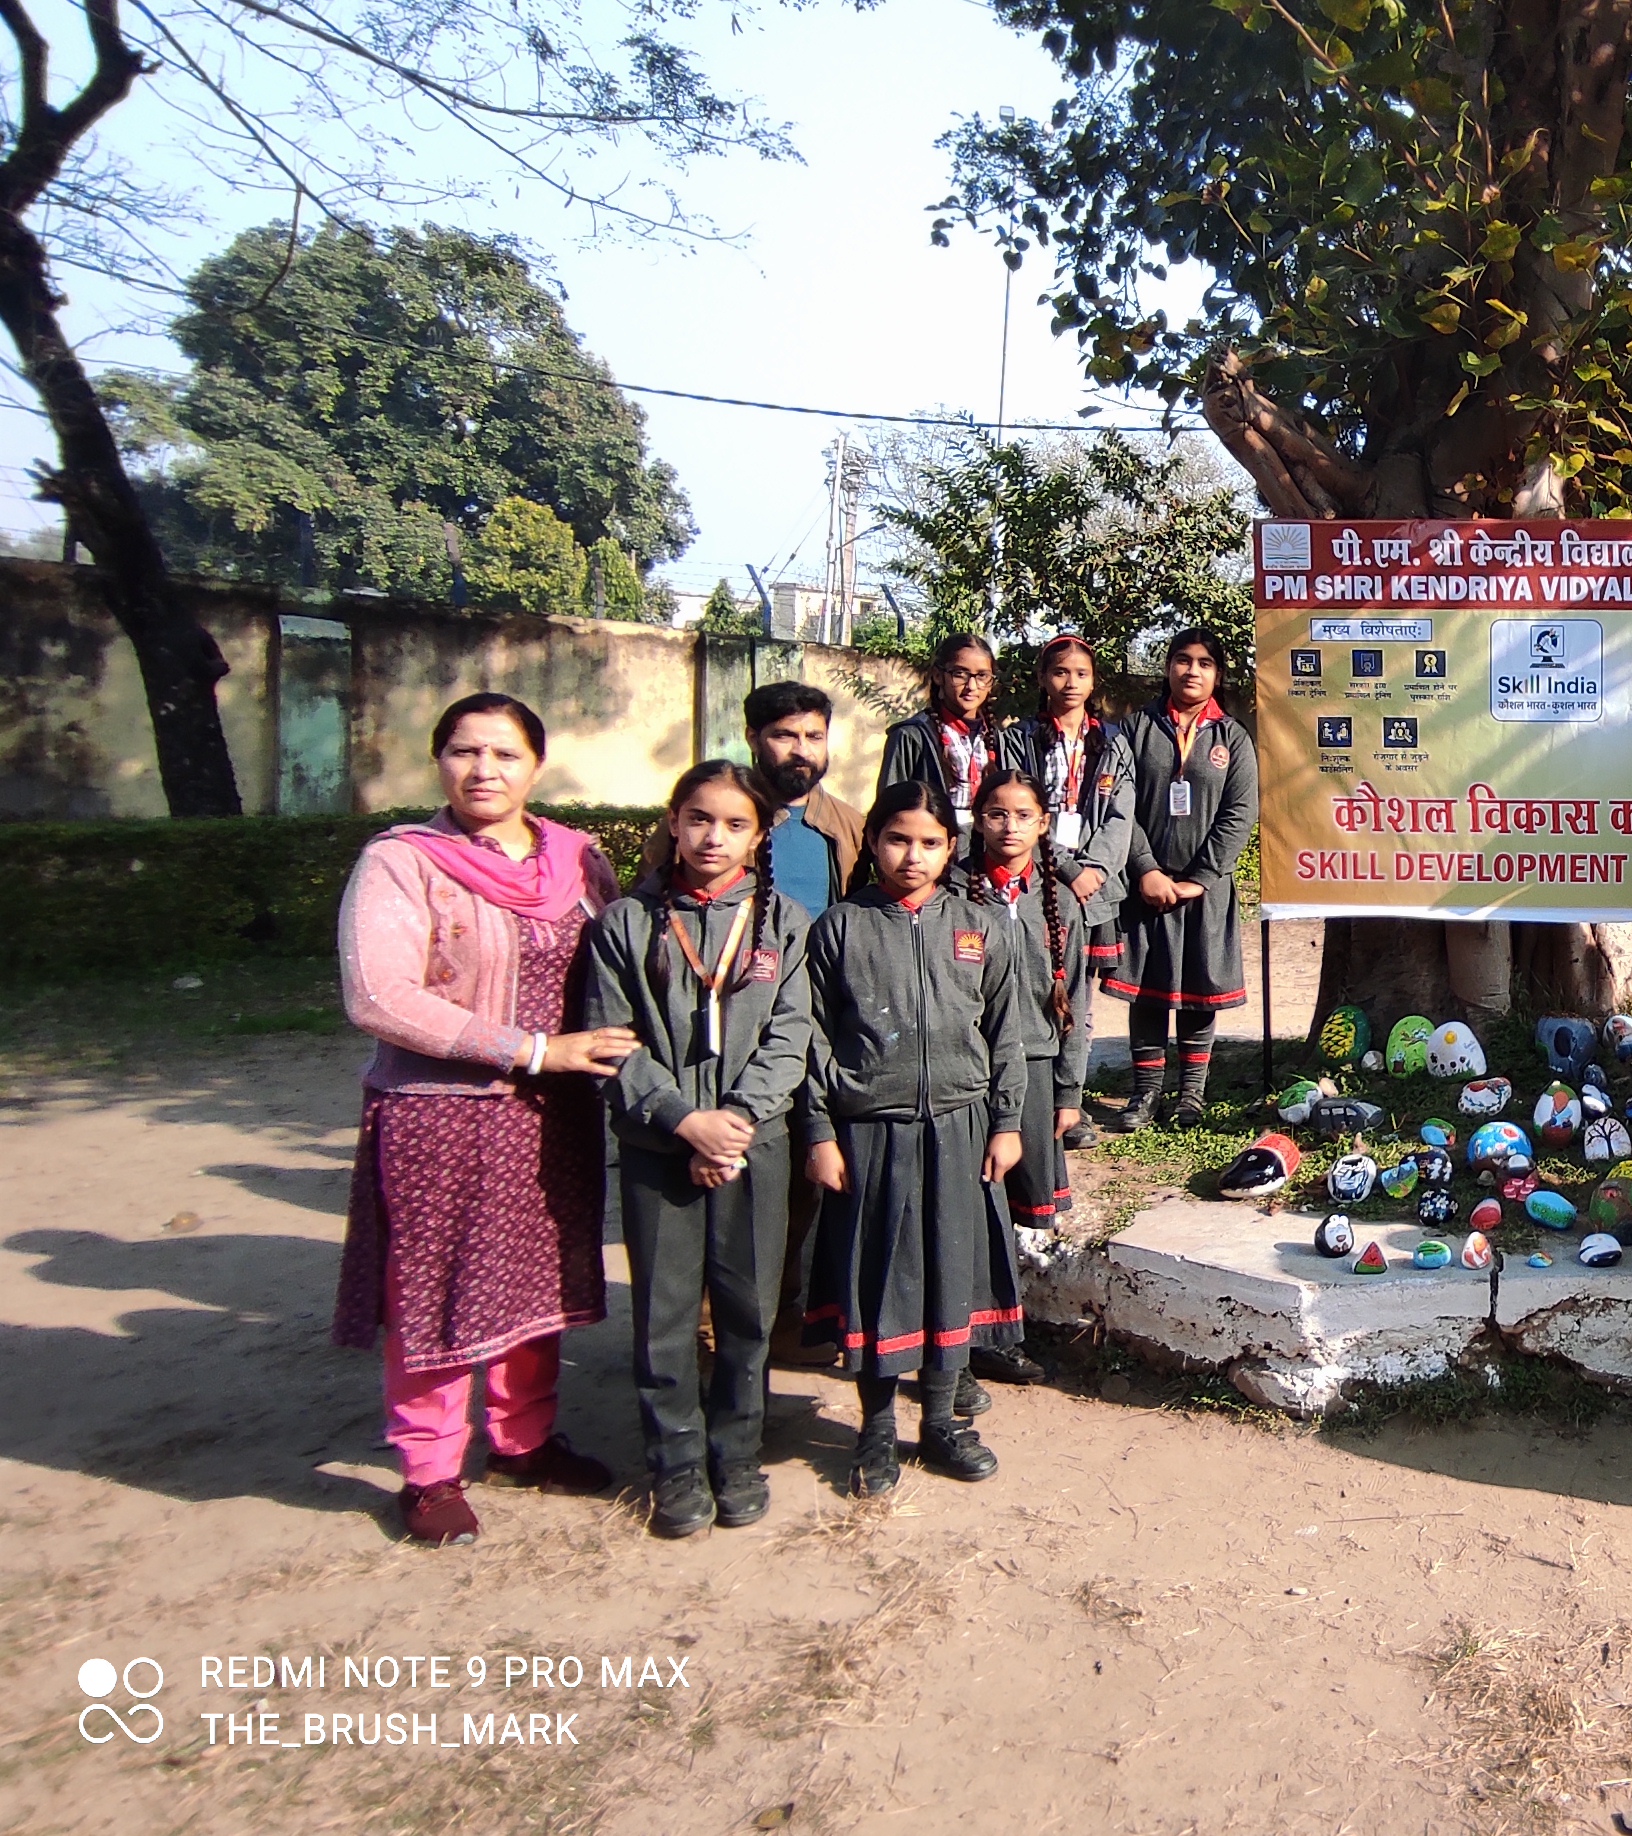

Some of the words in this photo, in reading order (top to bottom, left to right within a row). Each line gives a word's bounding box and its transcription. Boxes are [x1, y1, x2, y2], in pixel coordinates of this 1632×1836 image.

[1332, 529, 1420, 567] पी.एम.
[1429, 529, 1463, 567] श्री
[1469, 529, 1554, 568] केन्द्रीय
[1265, 575, 1307, 600] PM
[1314, 575, 1382, 600] SHRI
[1391, 576, 1533, 601] KENDRIYA
[1321, 623, 1350, 639] मुख्य
[1497, 674, 1540, 694] Skill
[1547, 676, 1597, 694] India
[1497, 699, 1524, 710] कौशल
[1577, 701, 1598, 710] भारत
[1332, 781, 1457, 833] कौशल
[1467, 782, 1600, 835] विकास
[1297, 850, 1385, 880] SKILL
[1395, 852, 1627, 883] DEVELOPMENT
